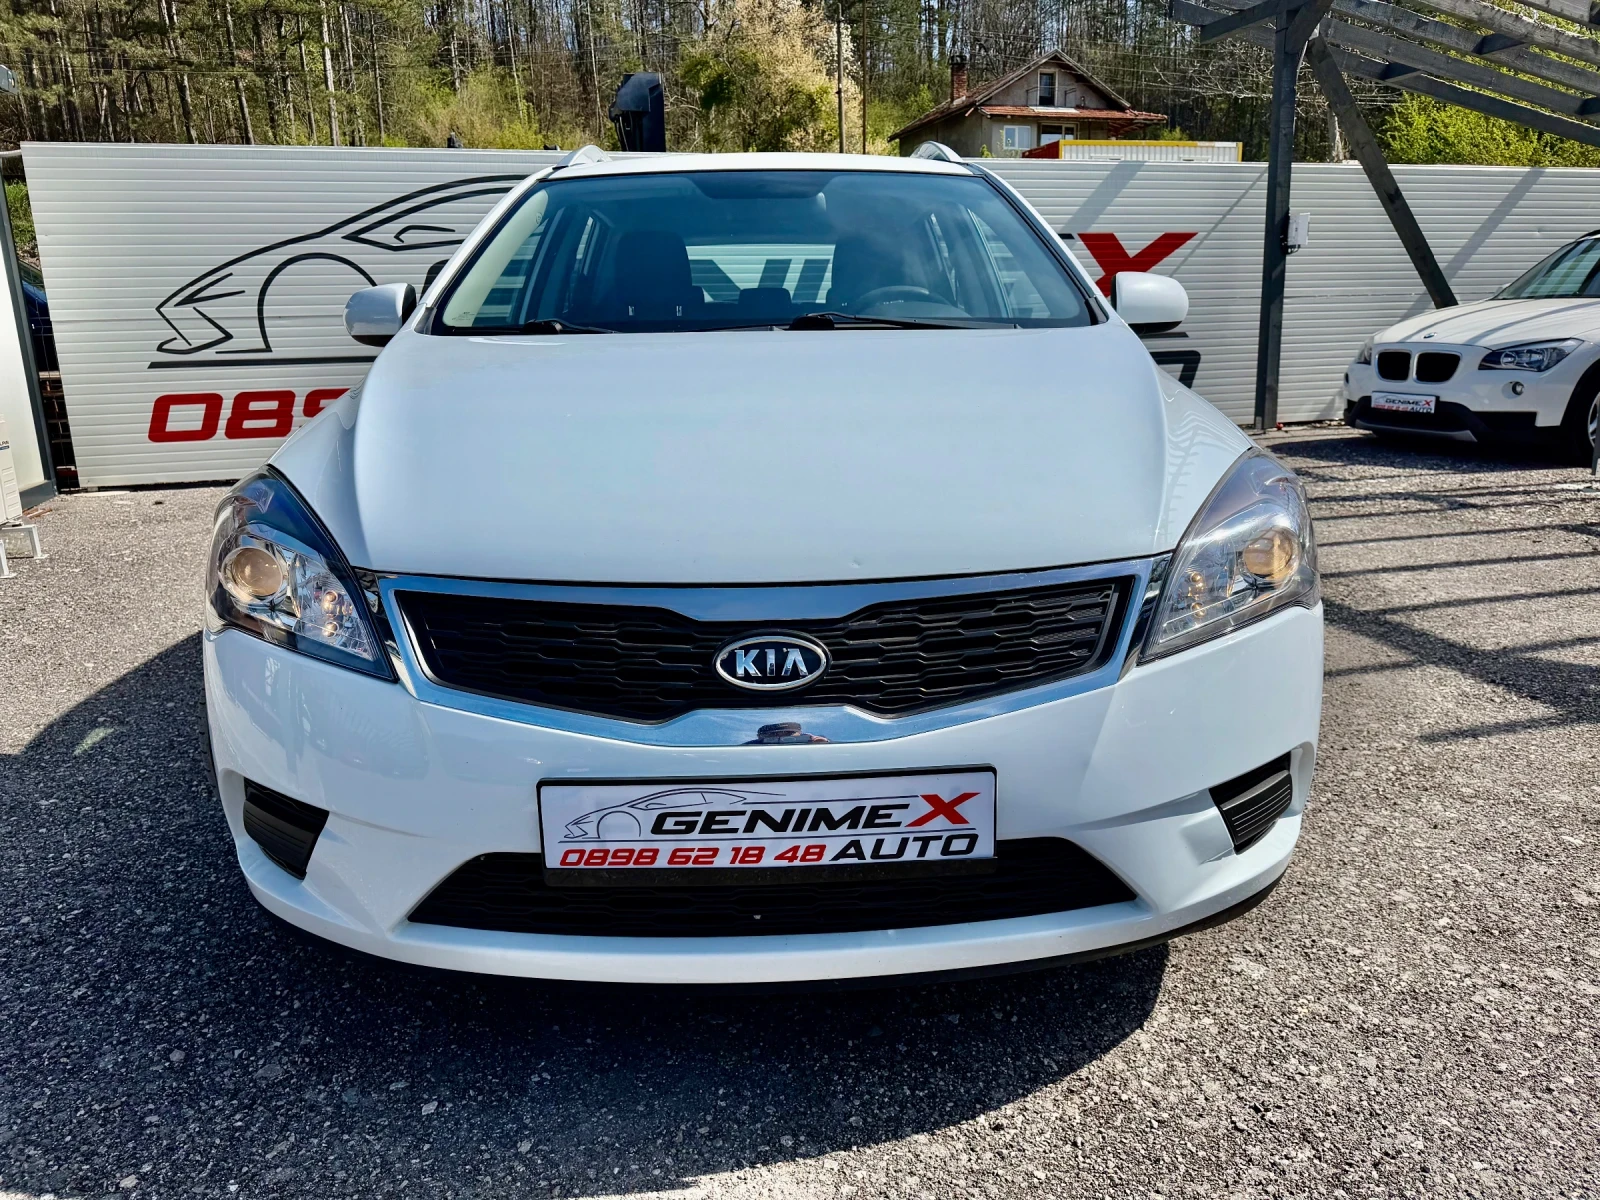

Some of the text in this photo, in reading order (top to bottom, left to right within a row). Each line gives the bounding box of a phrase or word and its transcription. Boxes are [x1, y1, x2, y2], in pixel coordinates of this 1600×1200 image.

[734, 648, 809, 677] KIA
[650, 792, 981, 835] GENIMEX
[559, 833, 979, 867] 0898 62 18 48 AUTO
